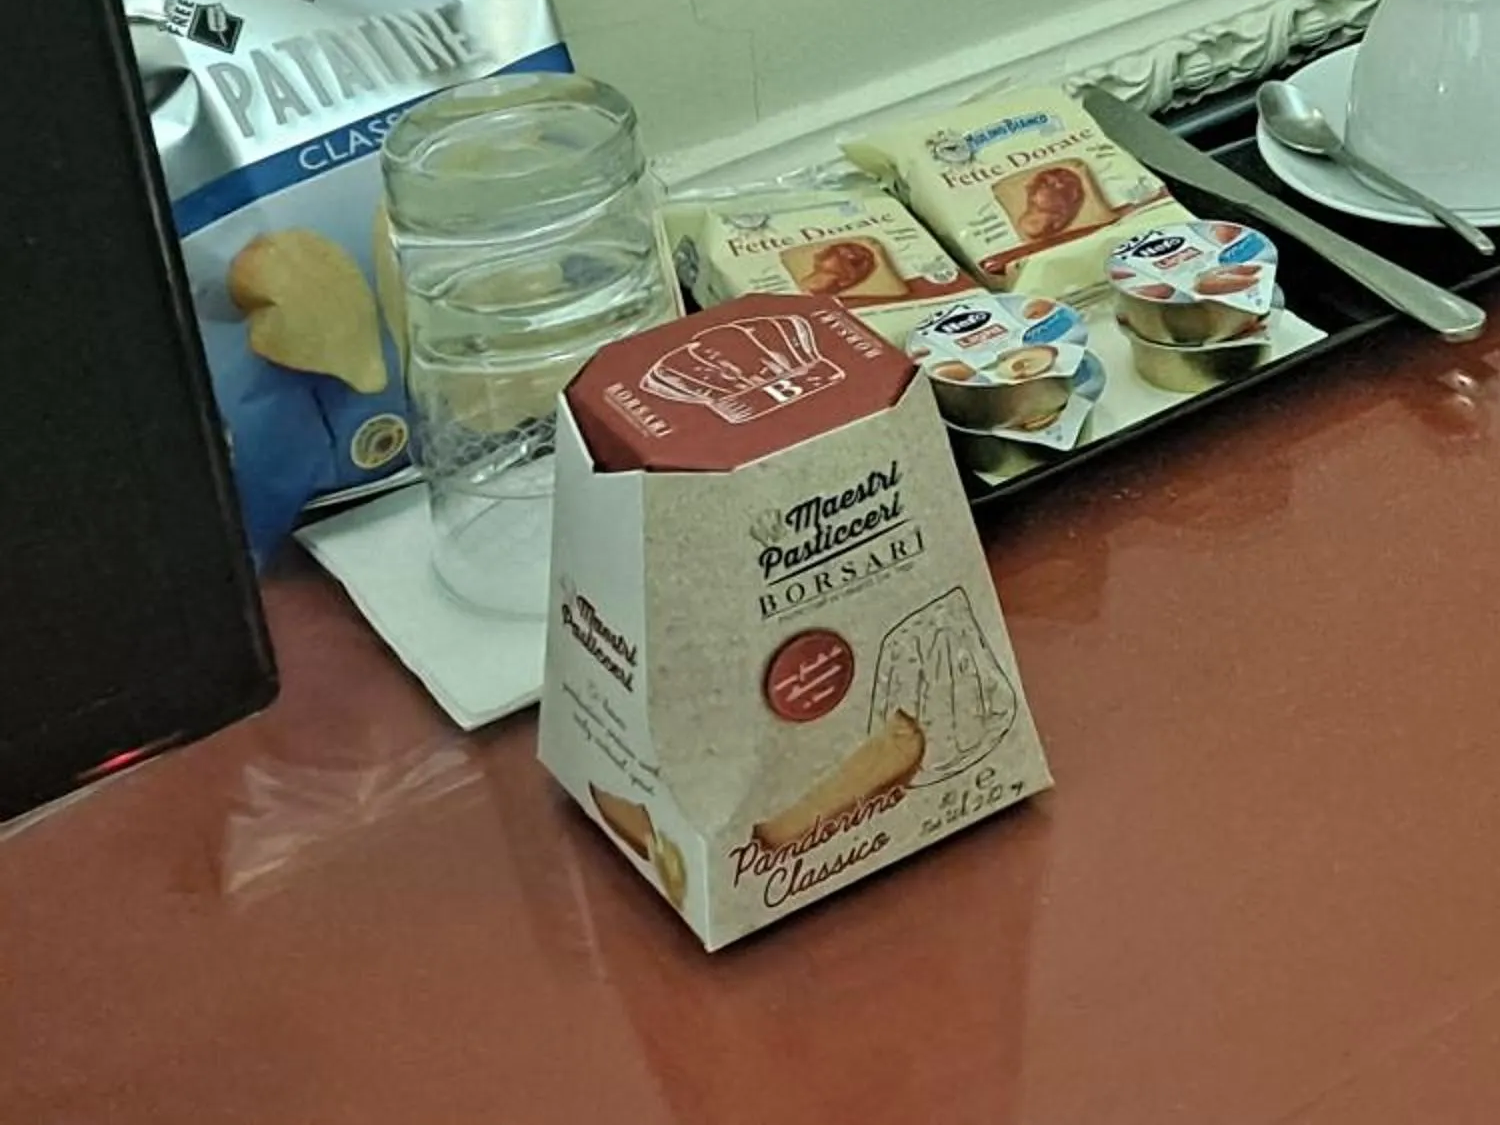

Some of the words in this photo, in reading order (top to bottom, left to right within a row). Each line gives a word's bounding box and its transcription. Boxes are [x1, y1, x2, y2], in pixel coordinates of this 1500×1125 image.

[941, 164, 1003, 189] Fette
[1006, 127, 1094, 168] Dorate
[727, 234, 794, 257] Fette
[758, 490, 905, 579] Pasticceri
[785, 460, 903, 534] Maestri
[759, 527, 925, 619] BORSARI
[728, 784, 904, 888] Pandorino
[763, 830, 891, 908] Classico
